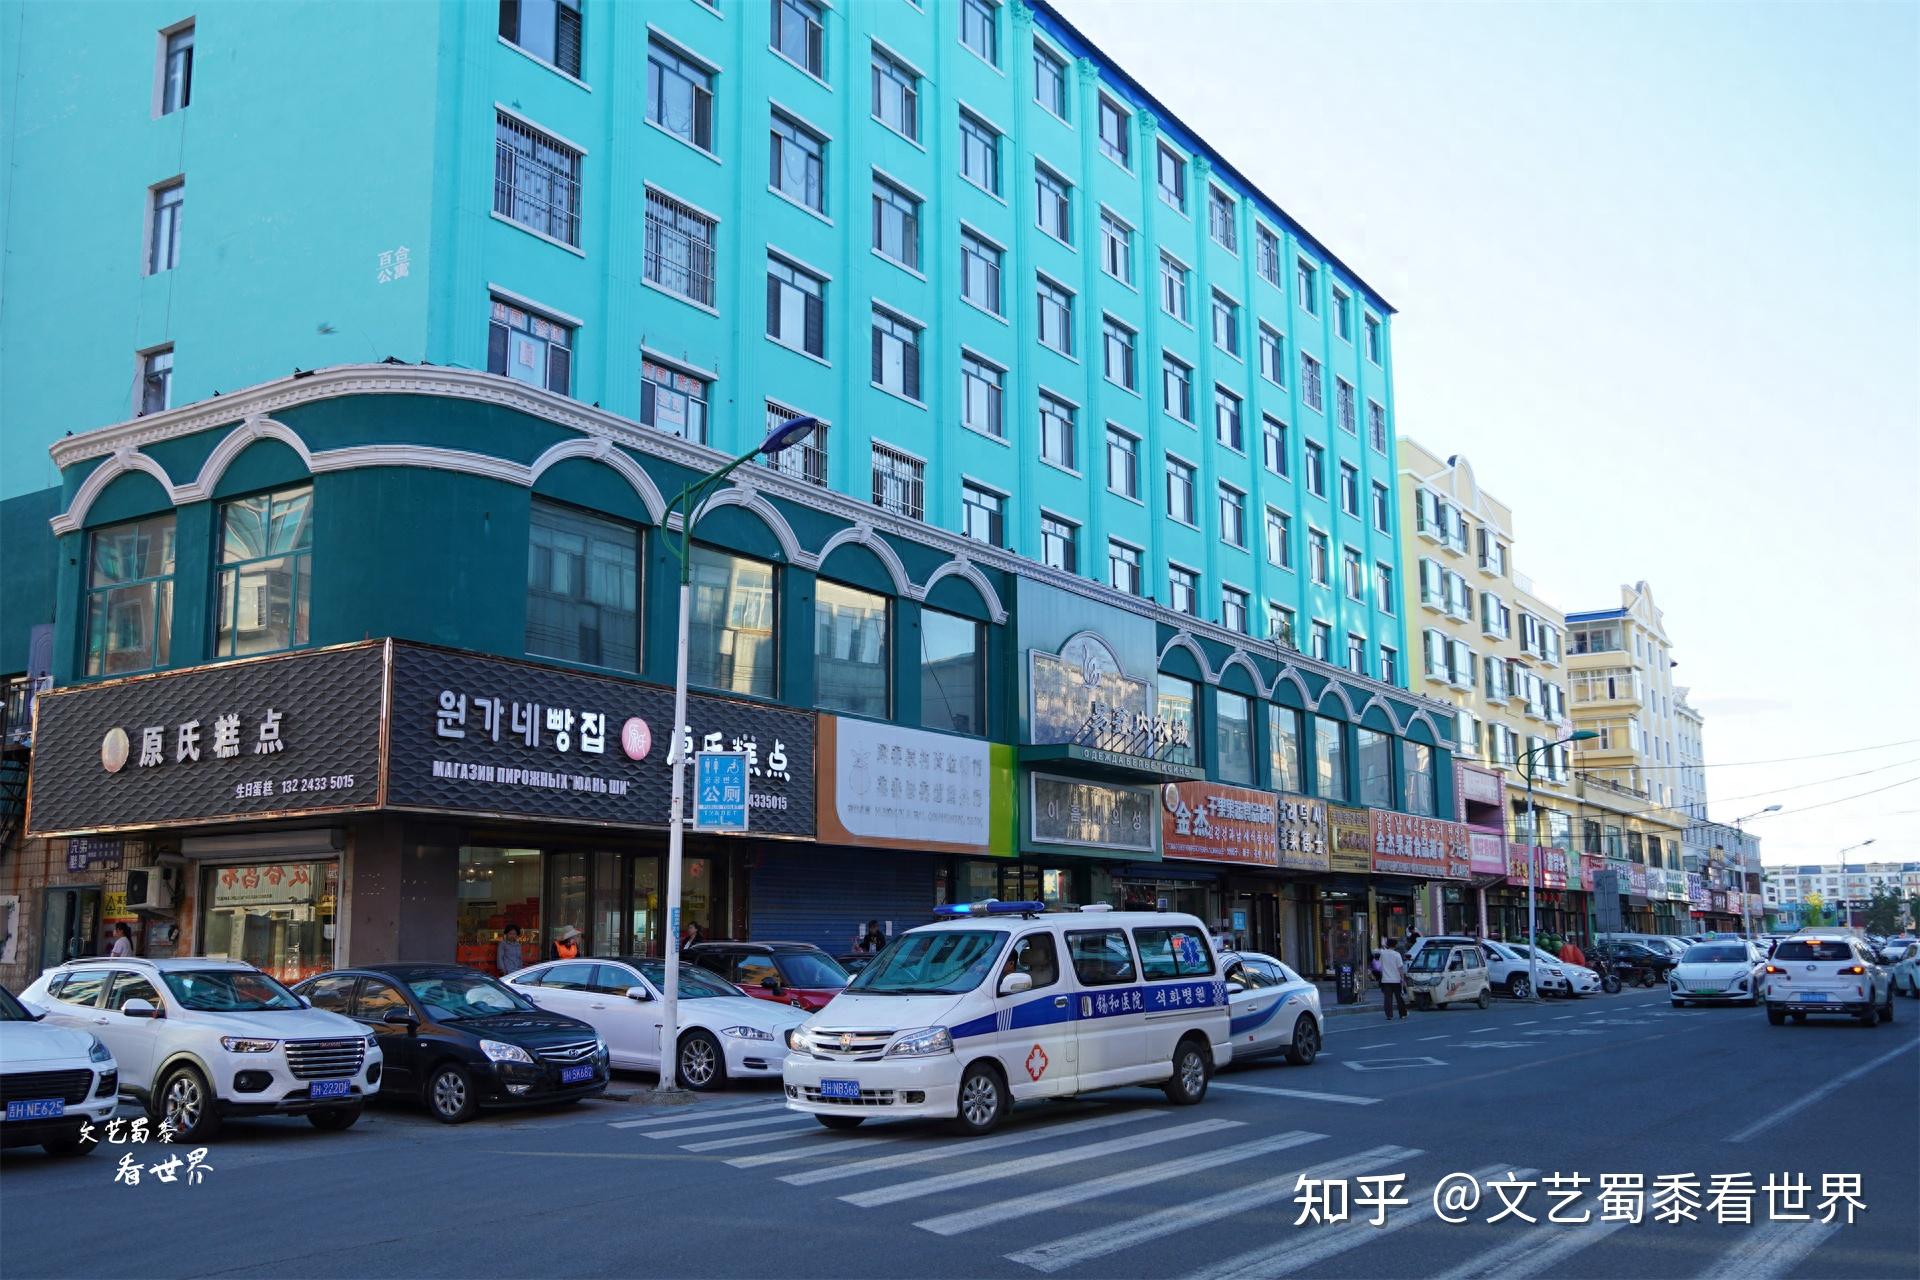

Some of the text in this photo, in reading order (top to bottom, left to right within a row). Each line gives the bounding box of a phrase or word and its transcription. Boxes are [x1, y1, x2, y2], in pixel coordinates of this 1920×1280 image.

[139, 708, 284, 768] 原氏糕点
[235, 774, 355, 799] 生日蛋糕 132 2433 5015
[432, 760, 495, 782] МАГАЗИН
[496, 767, 568, 790] ПИРОЖНЫХ
[703, 785, 741, 803] 公厕
[1175, 800, 1209, 837] 金杰
[1096, 991, 1143, 1015] 锡和医院
[1155, 986, 1206, 1007] 석화병원
